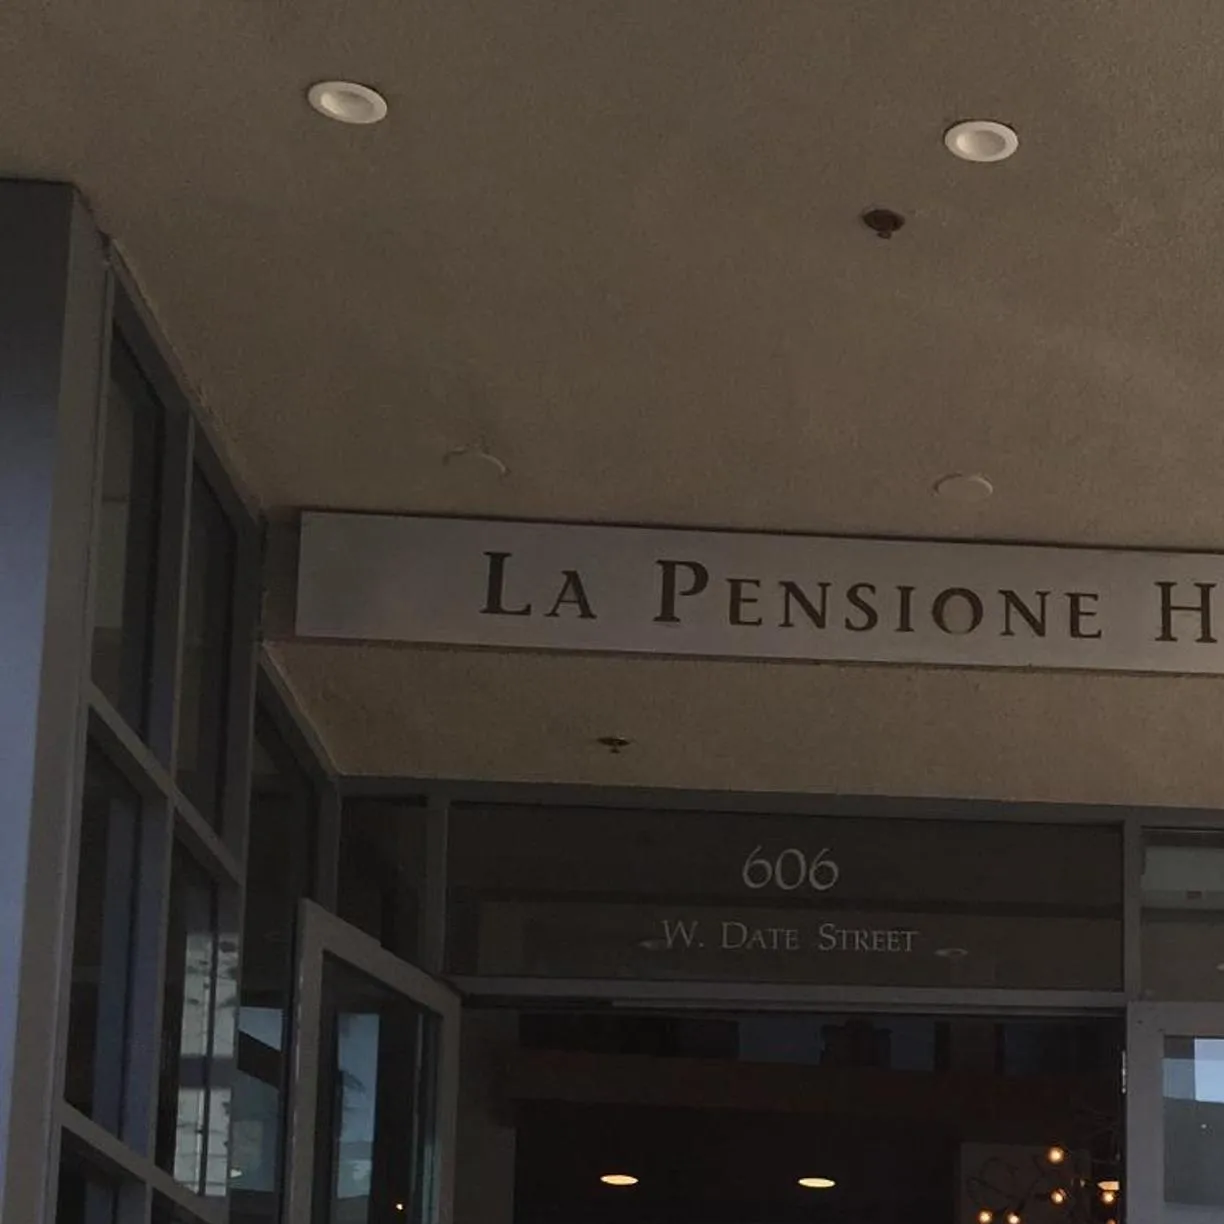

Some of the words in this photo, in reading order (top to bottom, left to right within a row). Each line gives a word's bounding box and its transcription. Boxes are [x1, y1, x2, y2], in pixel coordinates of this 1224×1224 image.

[652, 559, 1103, 638] PENSIONE
[742, 846, 839, 890] 606
[661, 919, 704, 948] W.
